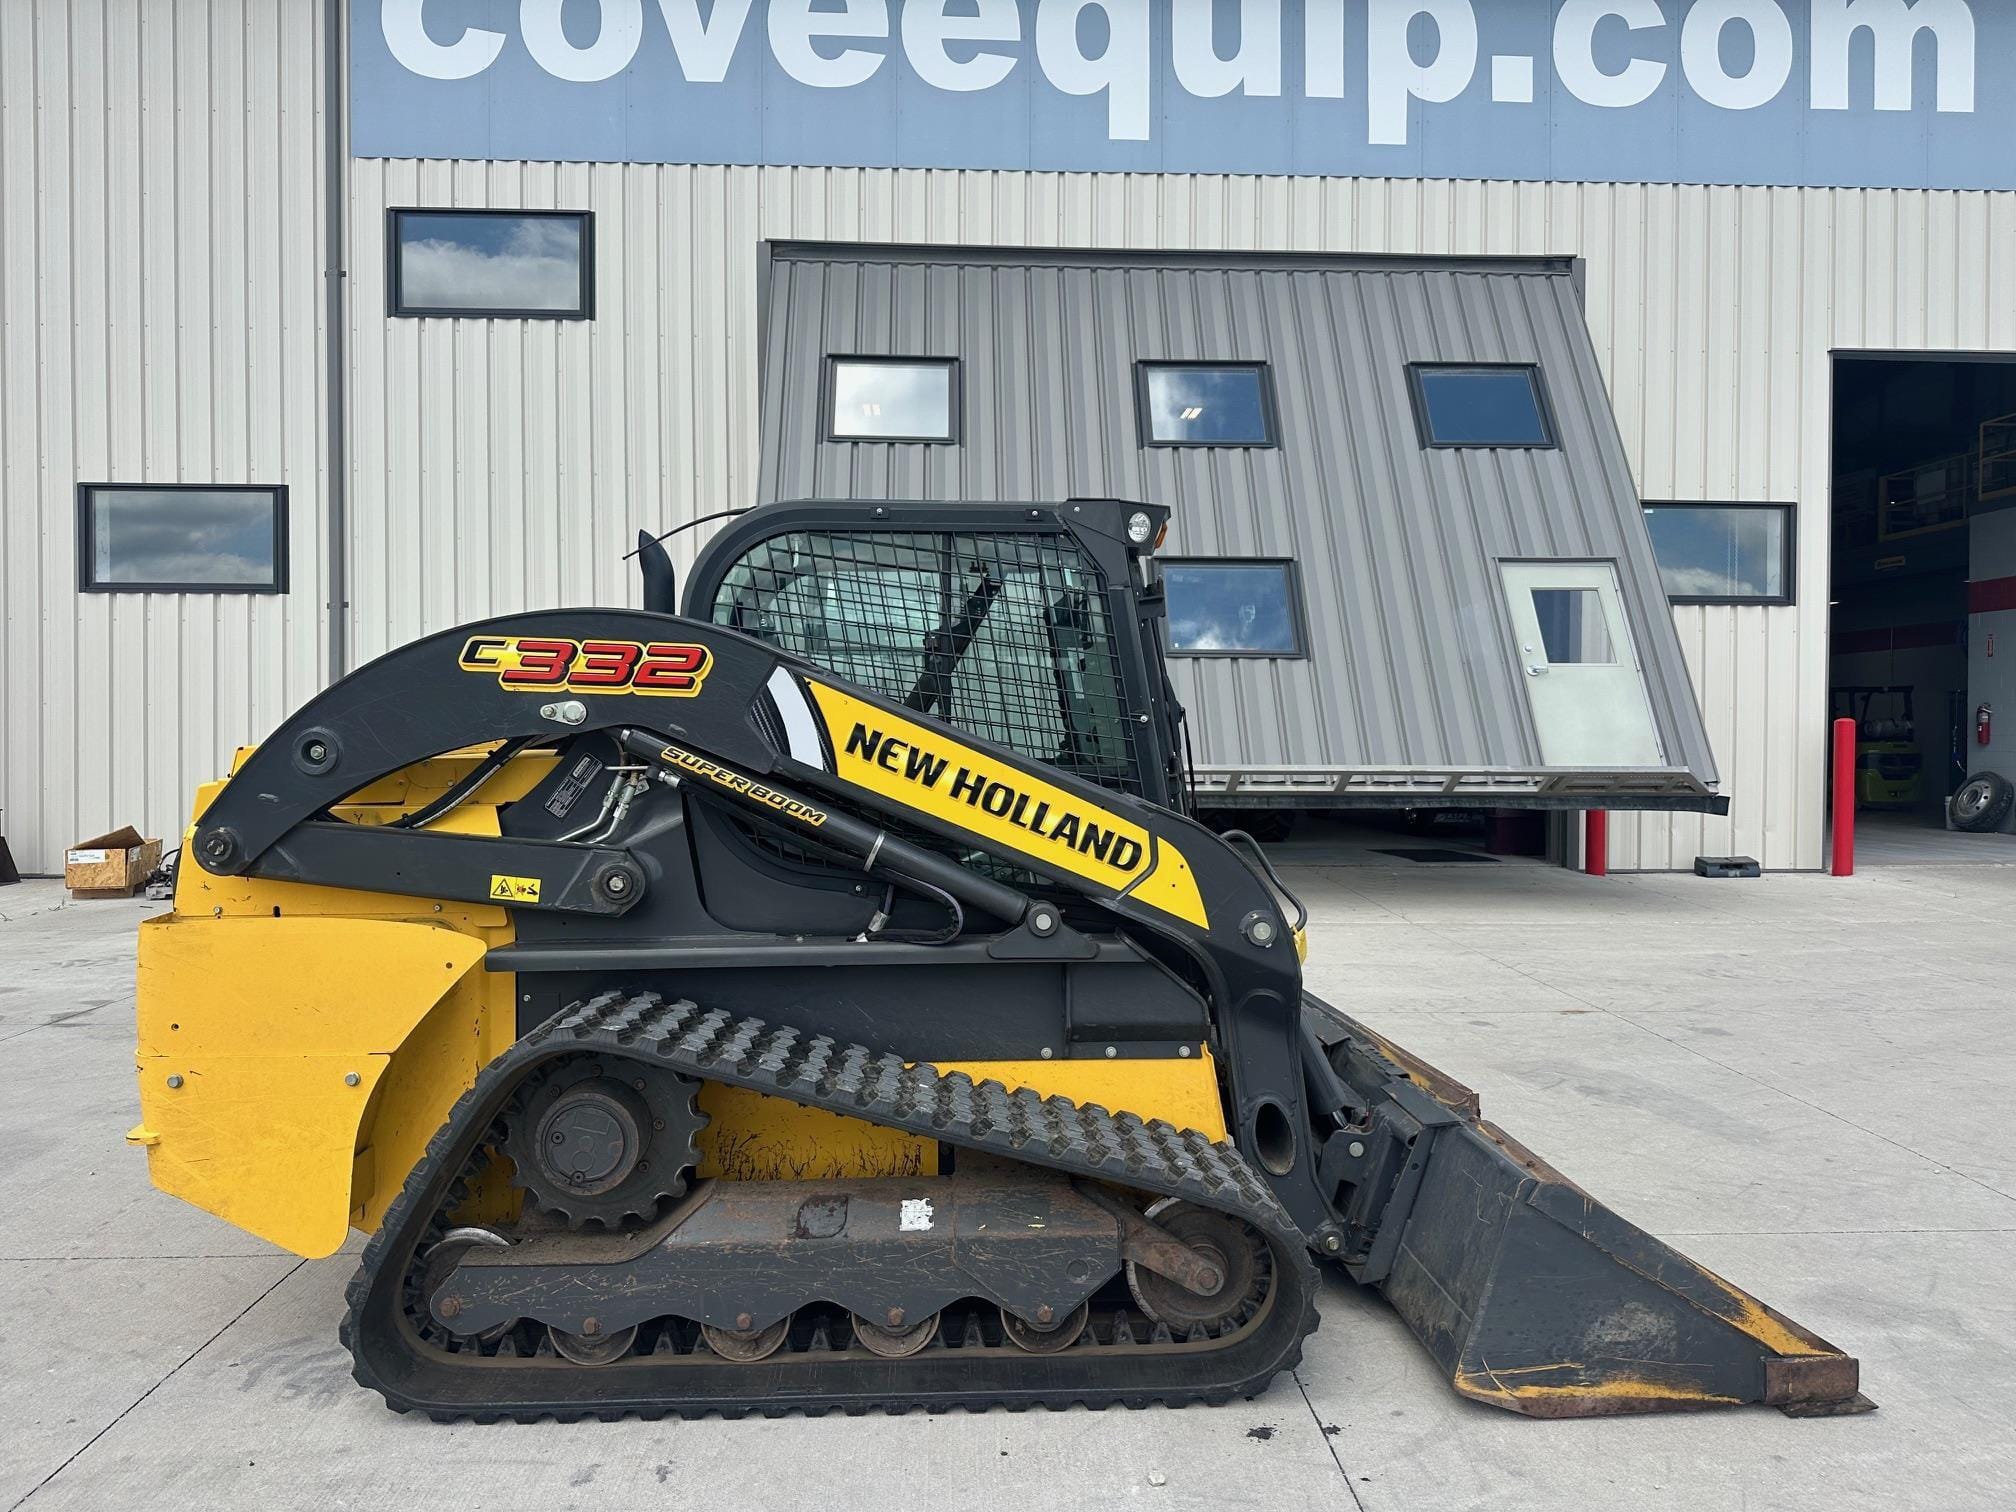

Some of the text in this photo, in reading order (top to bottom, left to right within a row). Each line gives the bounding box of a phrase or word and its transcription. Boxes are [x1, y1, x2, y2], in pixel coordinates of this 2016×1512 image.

[380, 0, 1975, 144] coveequip.com
[459, 635, 713, 697] C332
[845, 722, 1144, 872] NEW HOLLAND
